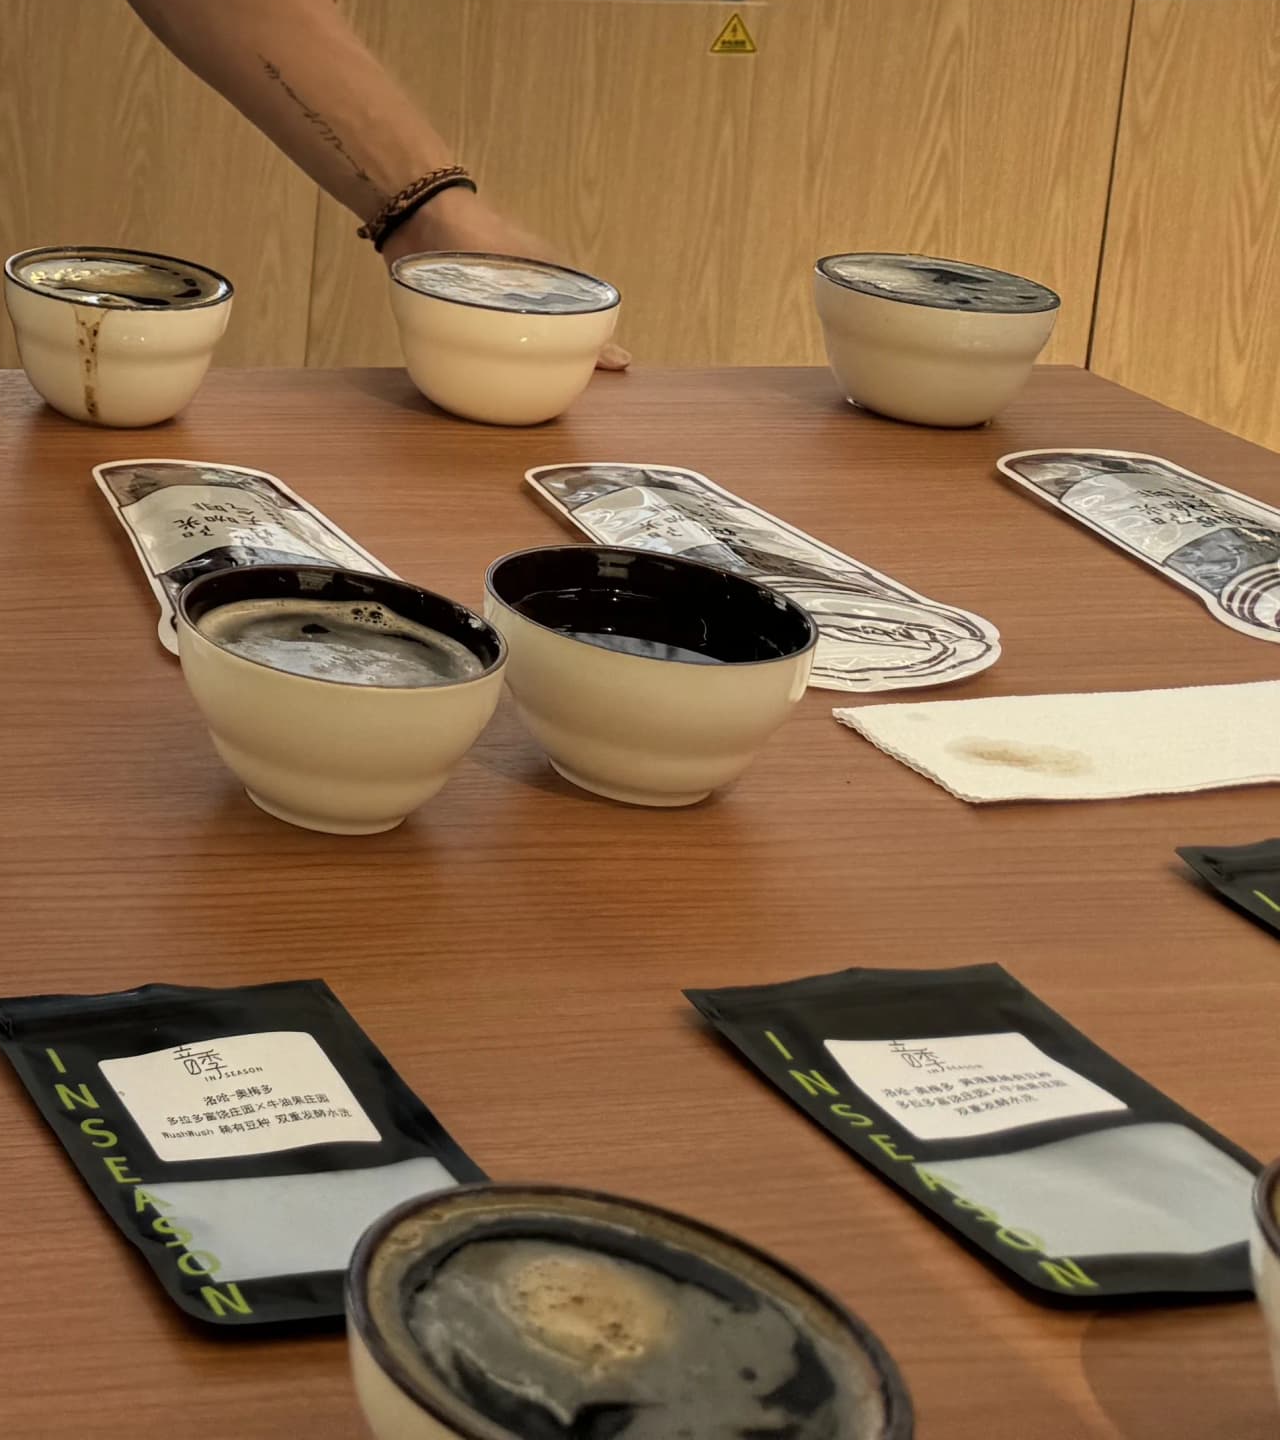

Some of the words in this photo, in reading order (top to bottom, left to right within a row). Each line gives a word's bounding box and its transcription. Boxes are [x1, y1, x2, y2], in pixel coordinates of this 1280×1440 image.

[45, 1048, 253, 1317] INSEASON
[225, 1066, 264, 1078] SEASON
[764, 1030, 1099, 1289] INSEASON
